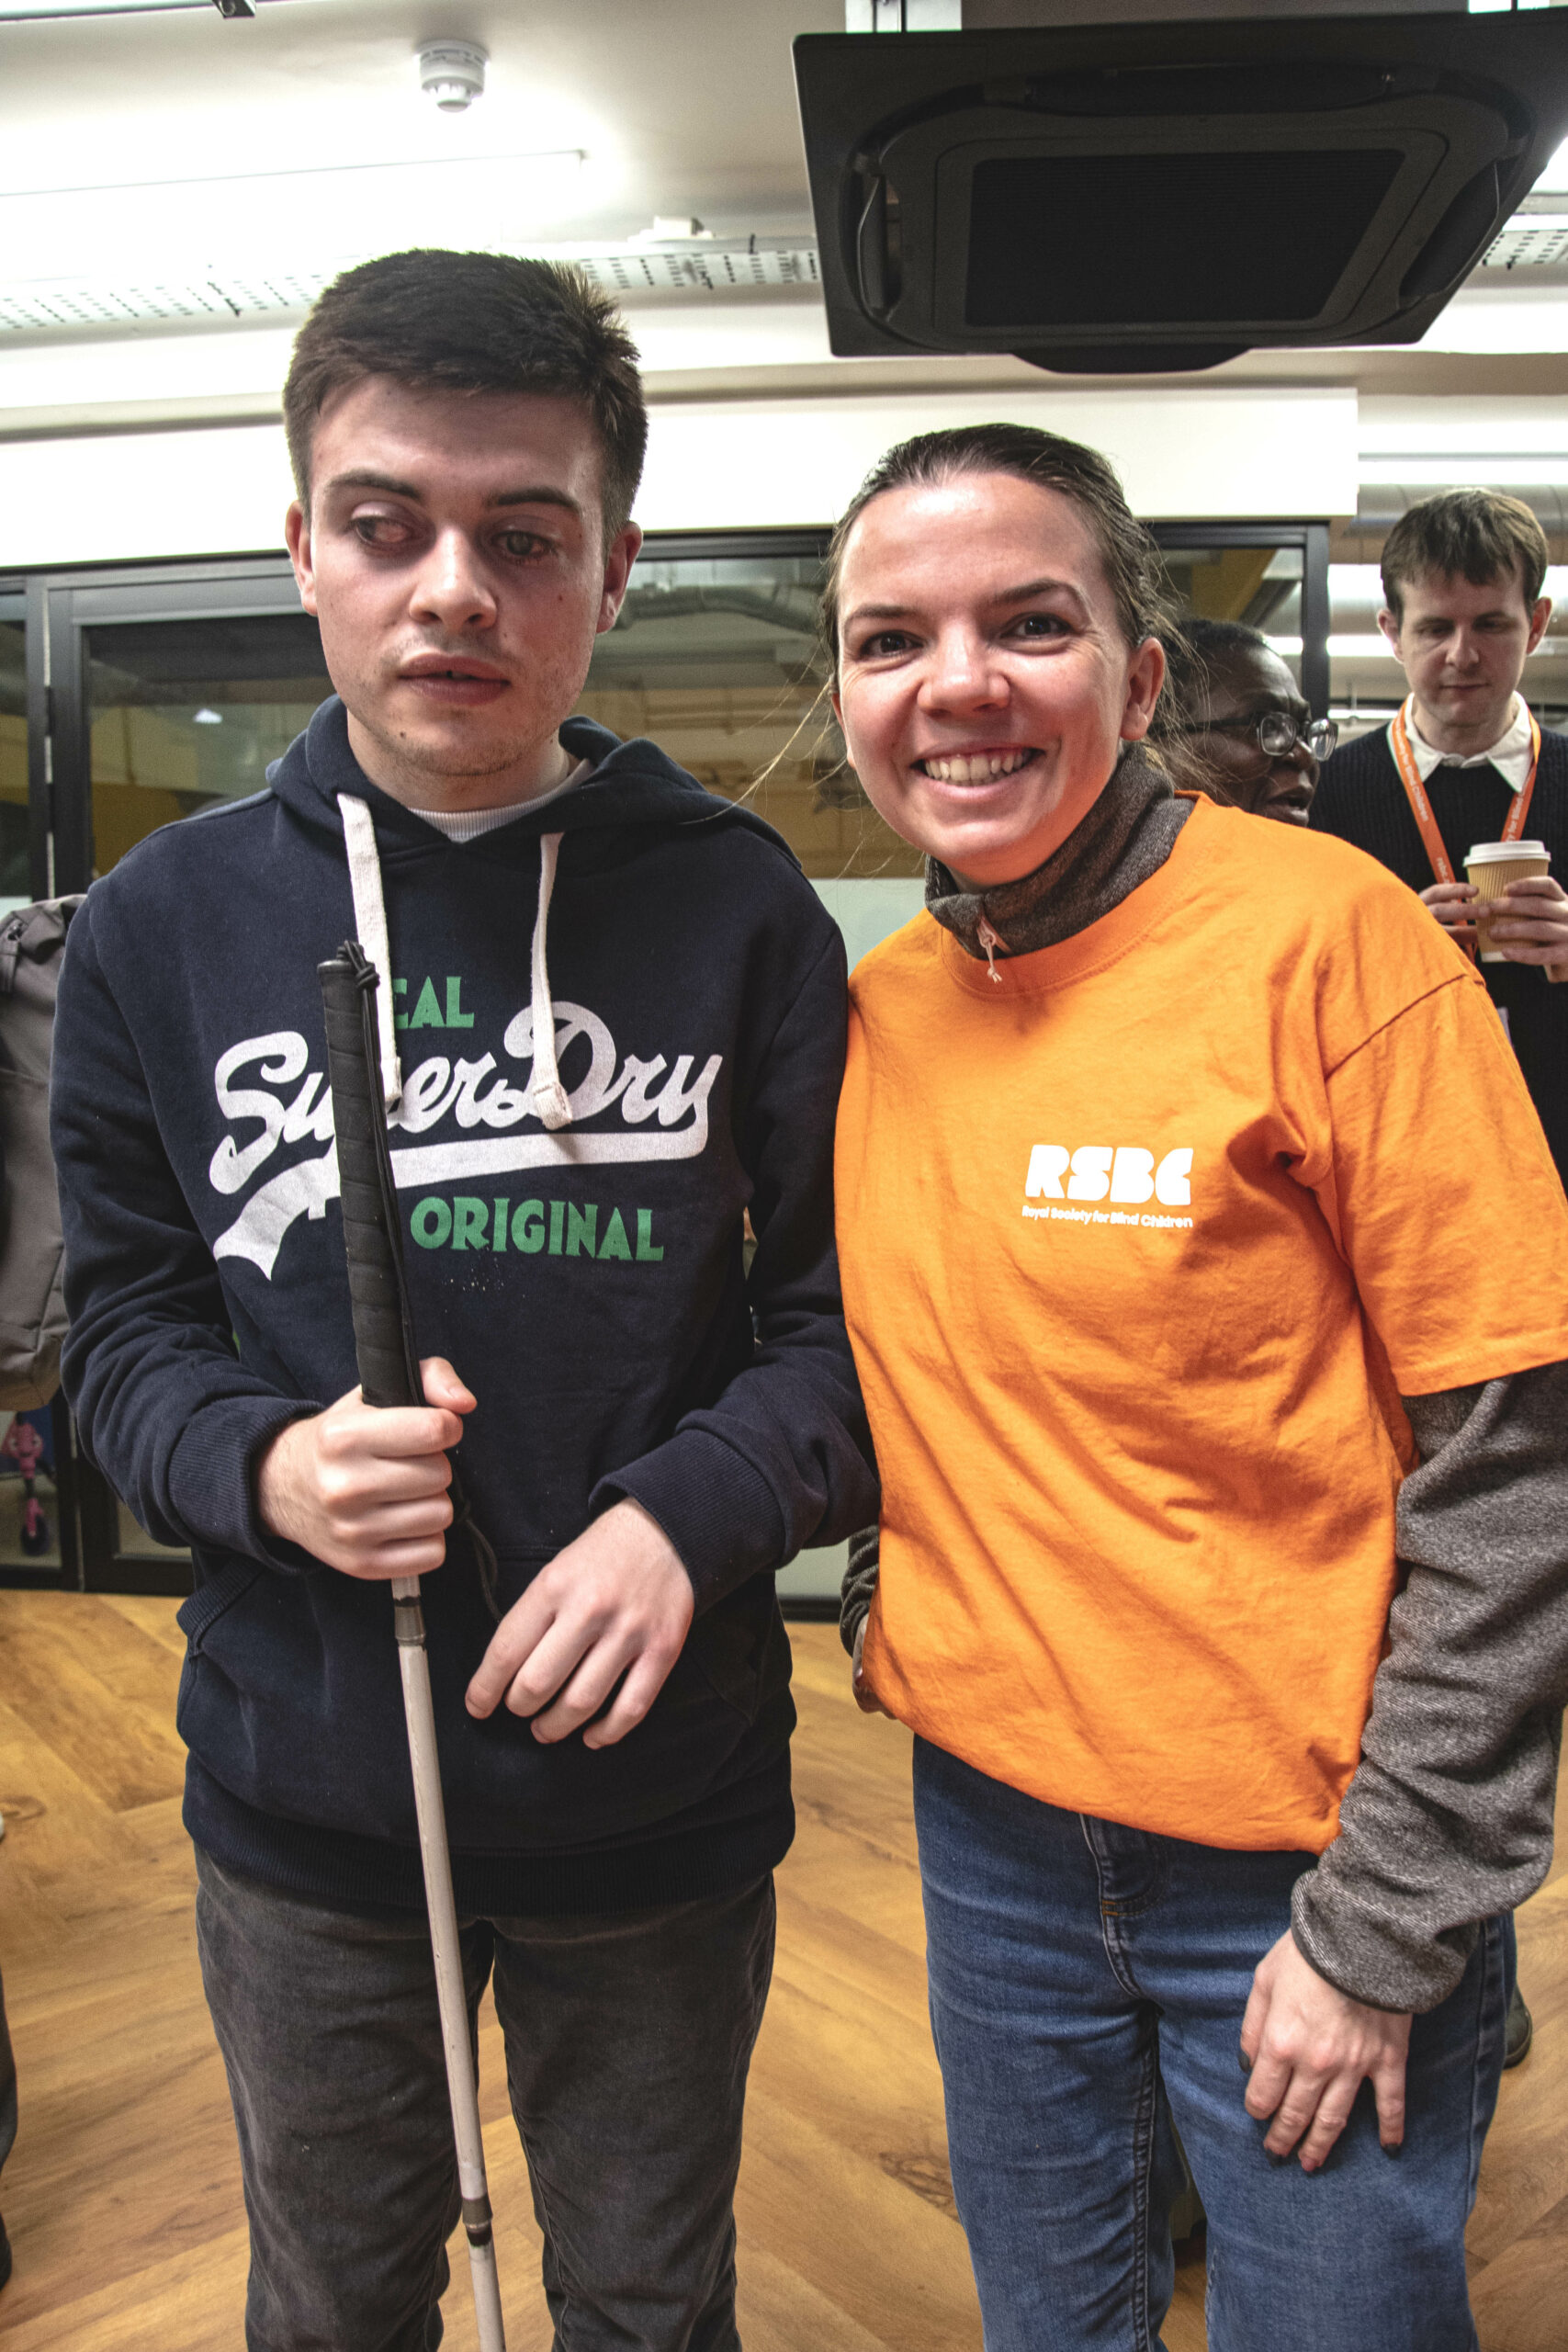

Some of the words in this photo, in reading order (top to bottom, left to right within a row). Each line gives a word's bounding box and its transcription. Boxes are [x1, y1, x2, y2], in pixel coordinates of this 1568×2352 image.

[1404, 765, 1417, 786] Blind
[1412, 786, 1429, 822] Children
[1510, 797, 1524, 820] Blind
[209, 1001, 723, 1194] SuerDry
[1025, 1145, 1194, 1205] RSBC
[410, 1196, 663, 1261] ORIGINAL
[1021, 1204, 1050, 1221] Royal
[1050, 1206, 1092, 1226] Society
[1092, 1209, 1111, 1224] for
[1110, 1211, 1140, 1227] Blind
[1140, 1214, 1193, 1228] Children
